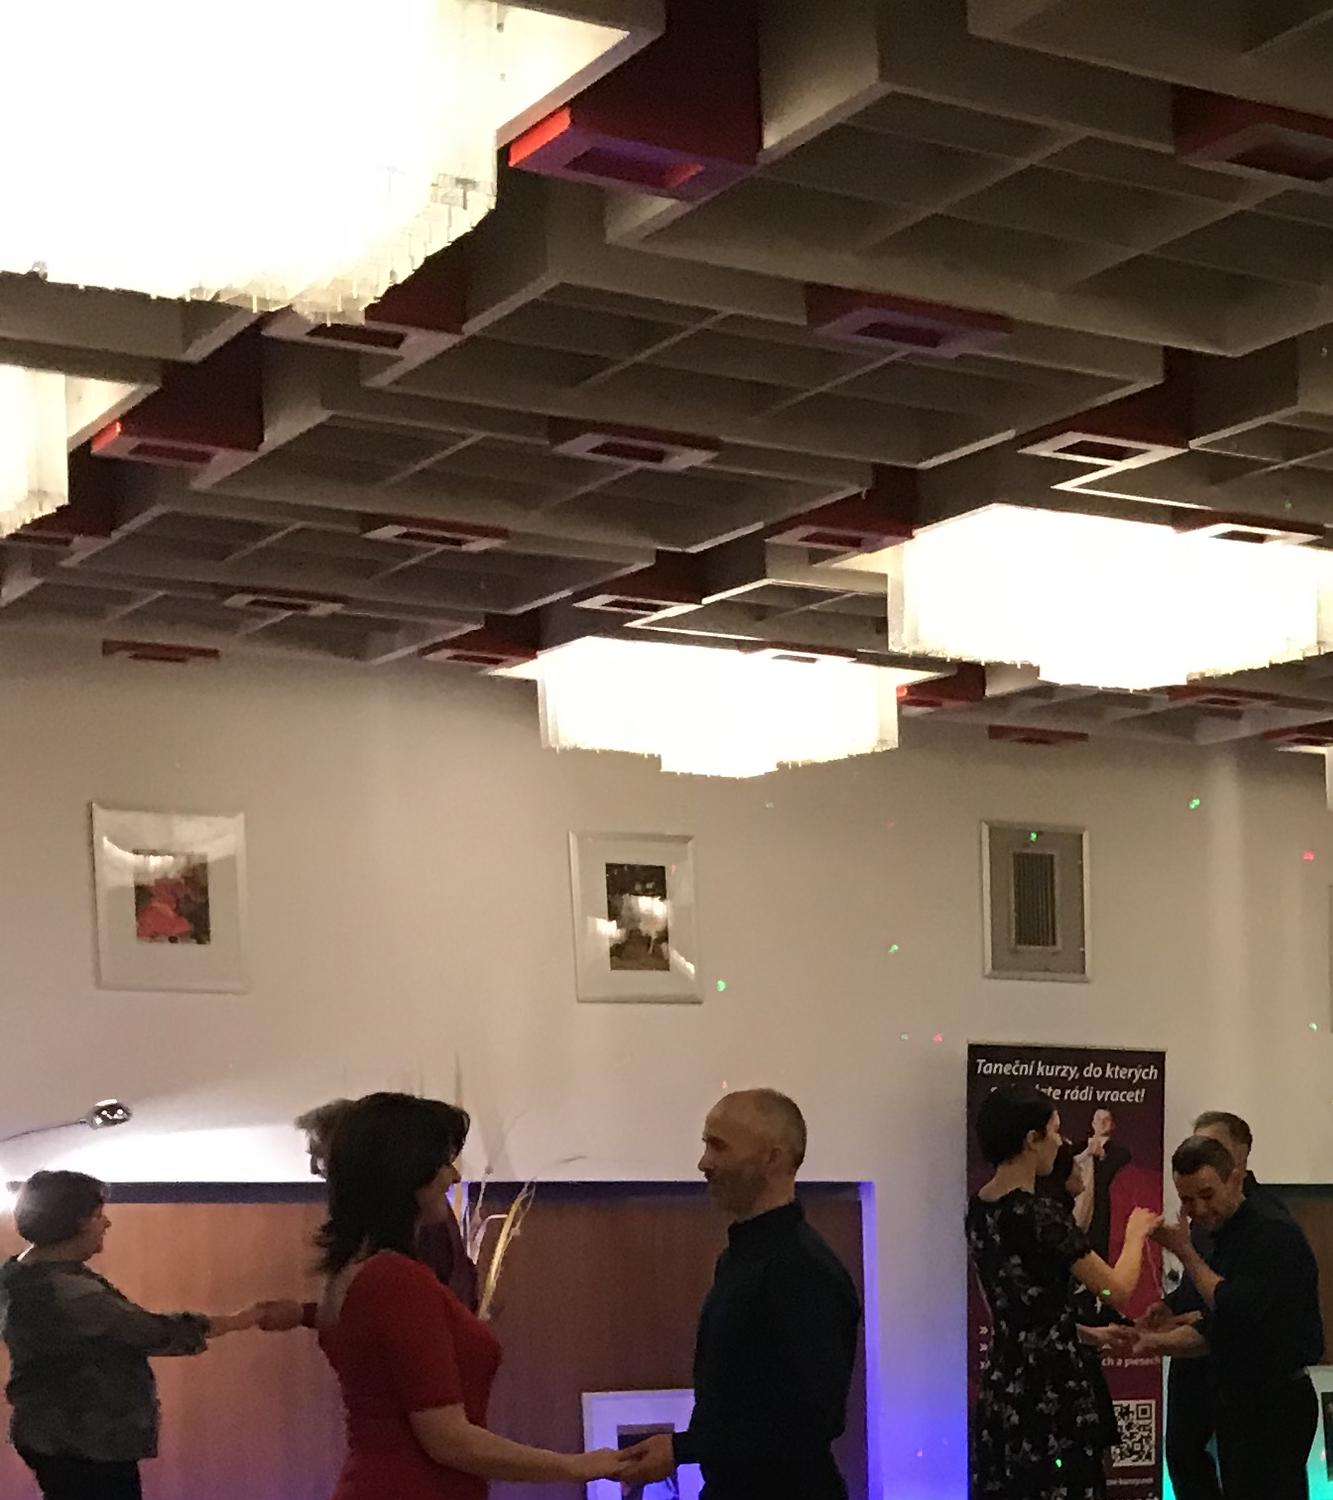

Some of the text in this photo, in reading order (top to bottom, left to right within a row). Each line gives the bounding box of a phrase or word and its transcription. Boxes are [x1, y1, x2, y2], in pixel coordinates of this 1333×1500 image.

[976, 1059, 1159, 1083] Taneční kurzy, do kterých
[1064, 1085, 1093, 1101] rádi
[1096, 1087, 1145, 1103] vracet!
